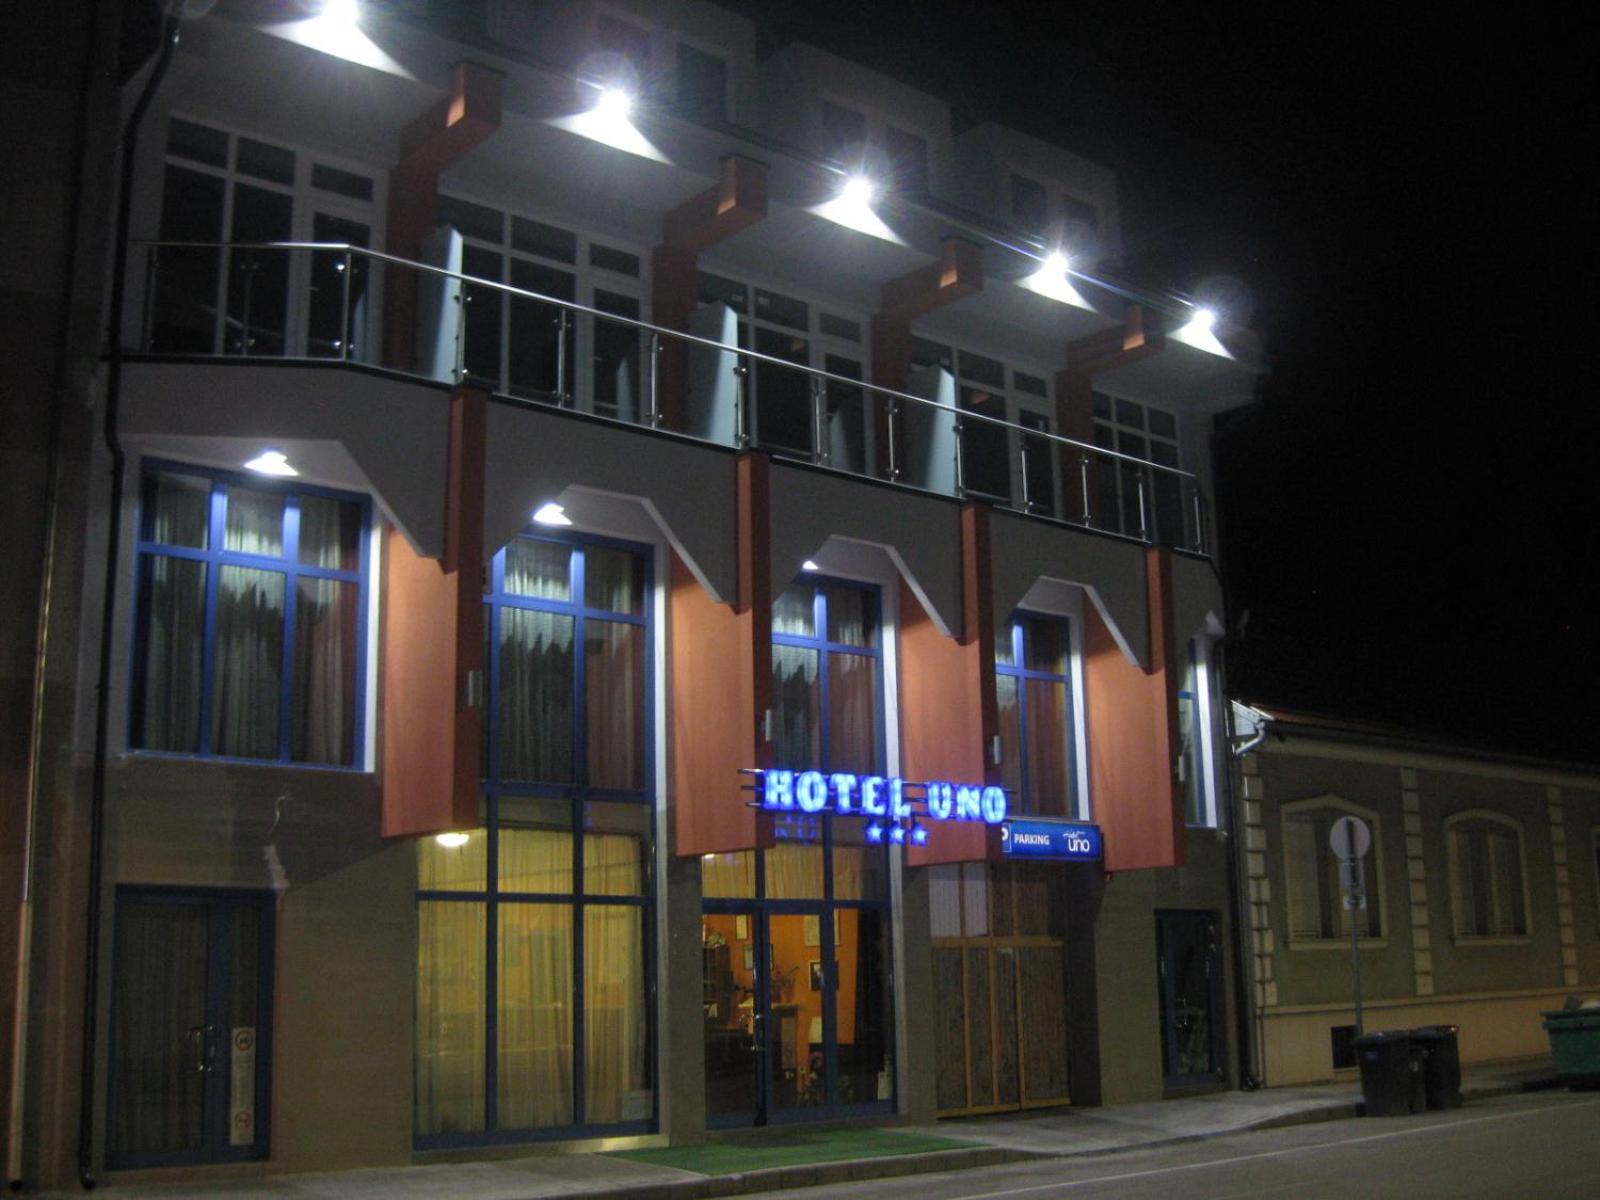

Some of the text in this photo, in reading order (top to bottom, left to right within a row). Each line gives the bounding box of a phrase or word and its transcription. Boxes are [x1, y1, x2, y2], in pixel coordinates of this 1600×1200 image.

[765, 770, 1006, 824] HOTEL UNO
[1014, 833, 1050, 845] PARKING
